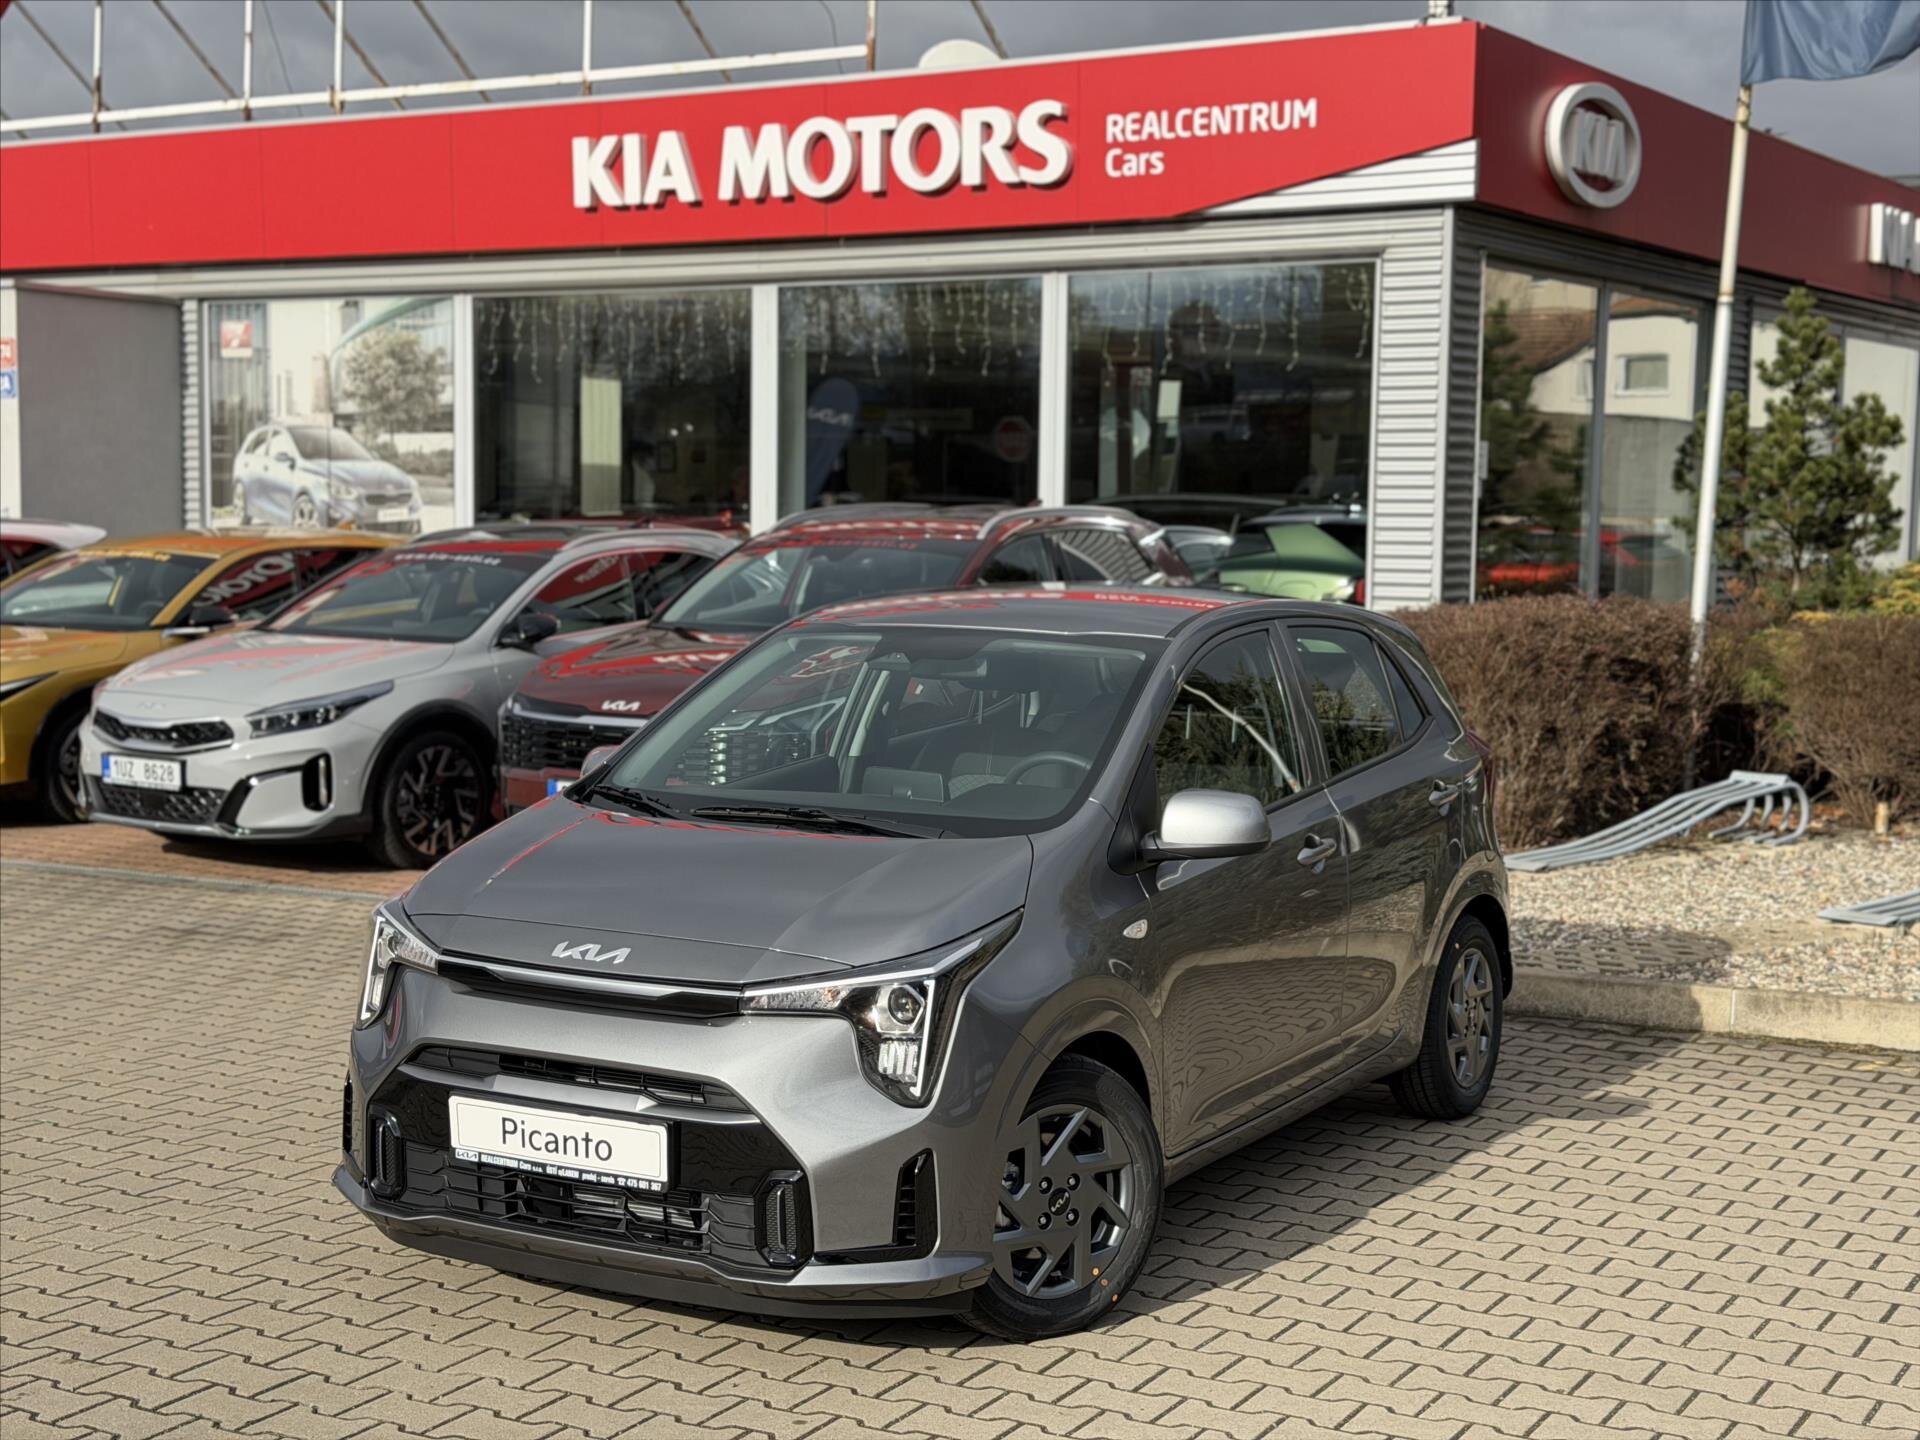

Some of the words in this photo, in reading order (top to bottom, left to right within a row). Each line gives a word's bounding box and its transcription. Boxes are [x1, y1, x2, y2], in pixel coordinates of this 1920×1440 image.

[1105, 97, 1318, 144] REALCENTRUM
[571, 130, 699, 209] KIA
[718, 98, 1073, 203] MOTORS
[1105, 147, 1165, 178] Cars
[601, 699, 641, 711] KIA
[113, 759, 135, 778] 1UZ
[144, 763, 174, 783] 8628
[551, 940, 632, 965] KIA
[501, 1116, 613, 1162] Picanto
